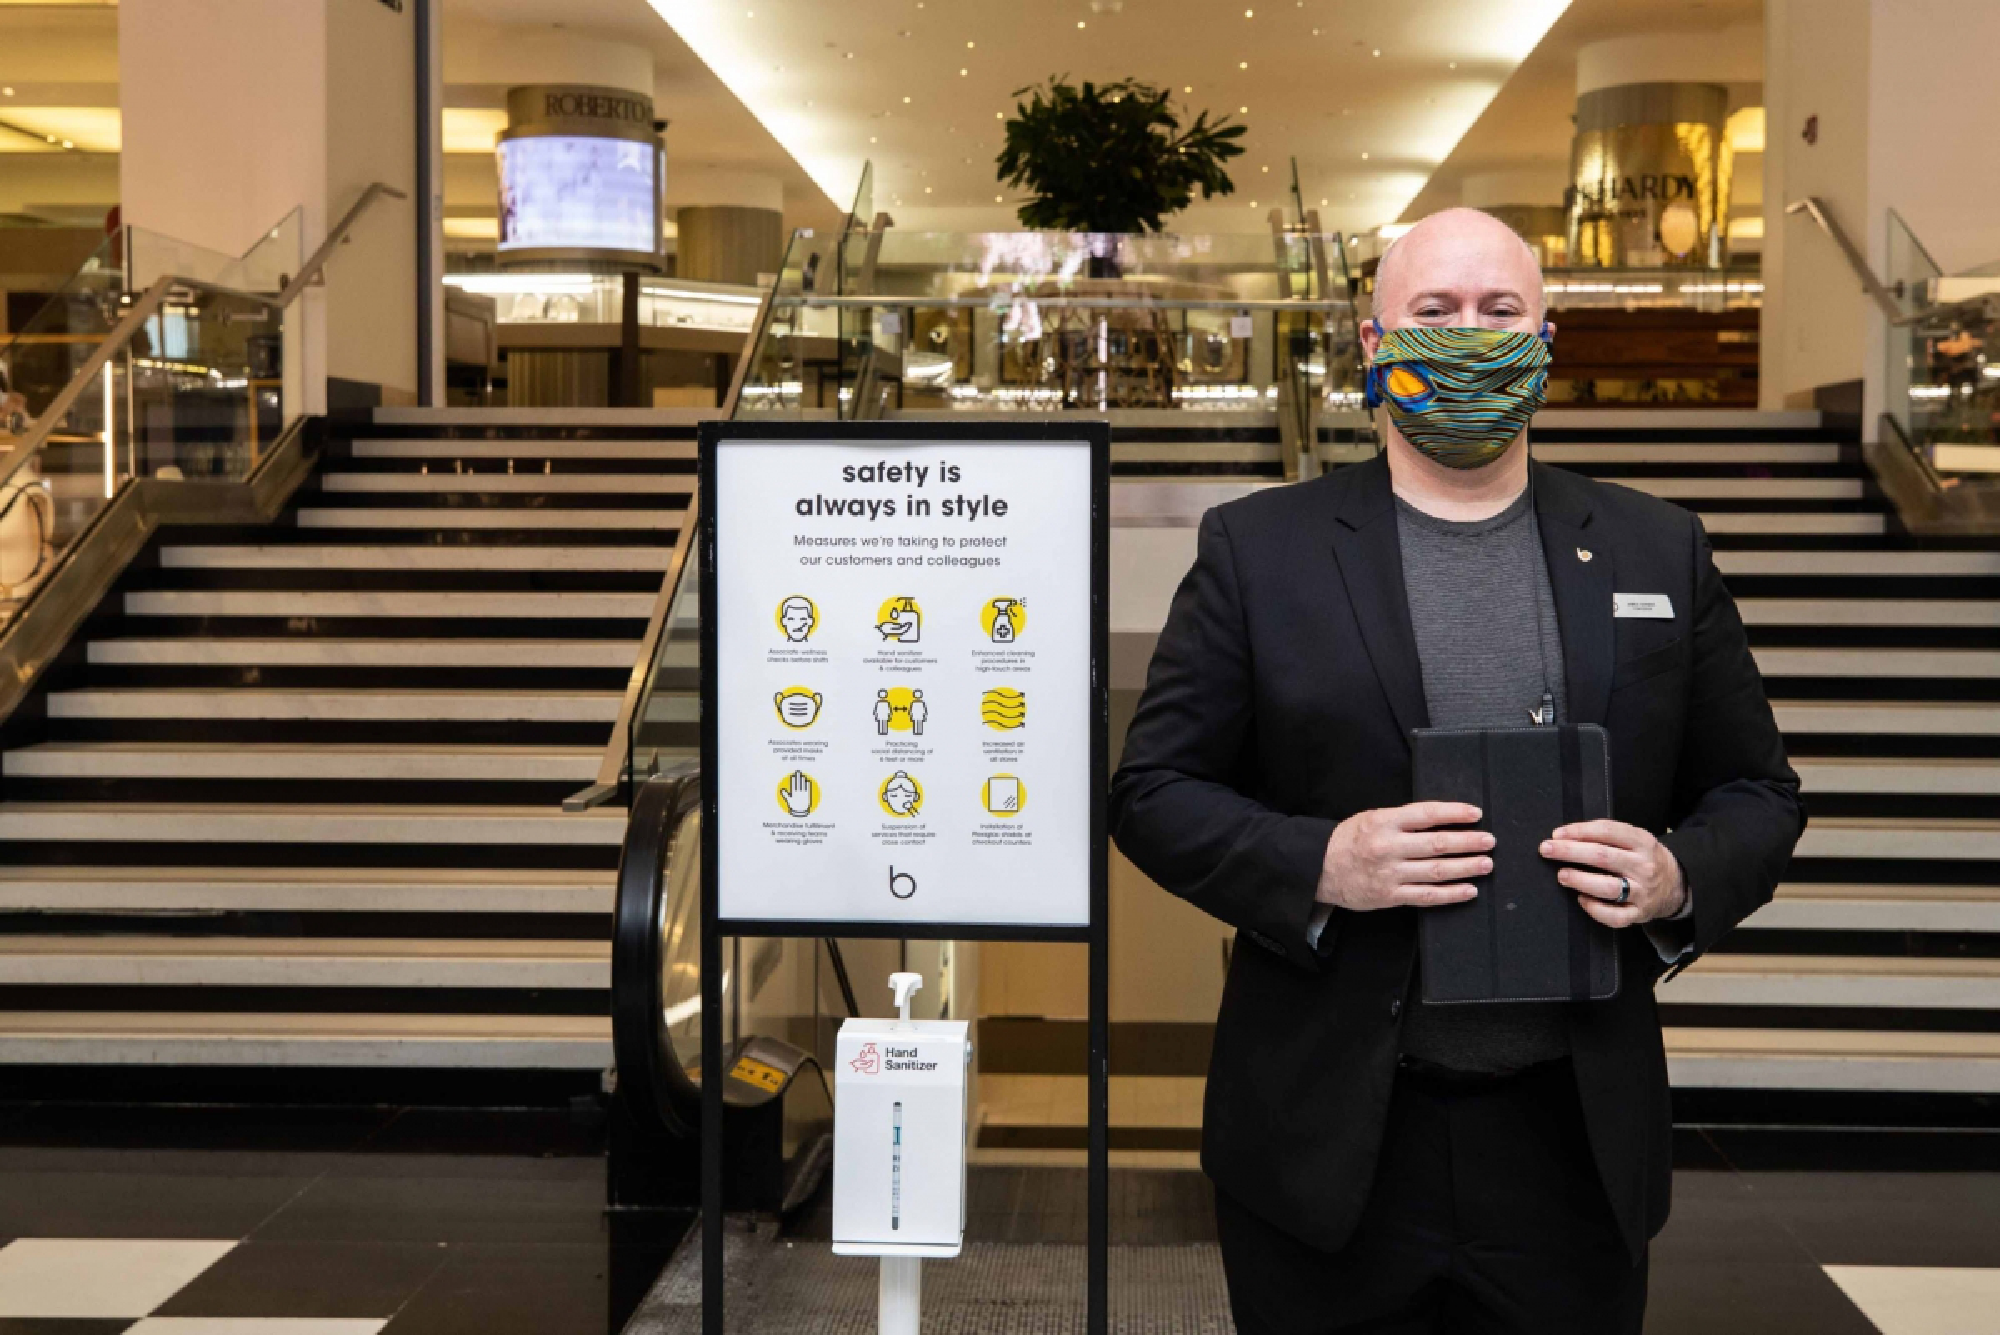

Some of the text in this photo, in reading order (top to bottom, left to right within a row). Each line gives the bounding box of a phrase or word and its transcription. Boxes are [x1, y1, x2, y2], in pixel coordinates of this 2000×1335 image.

[544, 92, 645, 122] ROBERTO
[1597, 175, 1698, 202] HARDY
[842, 460, 961, 487] safety is
[795, 494, 1008, 521] always in style
[794, 534, 1008, 550] Measures we're taking to protect
[800, 554, 1001, 568] our customers and colleagues
[889, 865, 917, 900] b
[885, 1047, 918, 1058] Hand
[885, 1059, 938, 1071] Sanitizer
